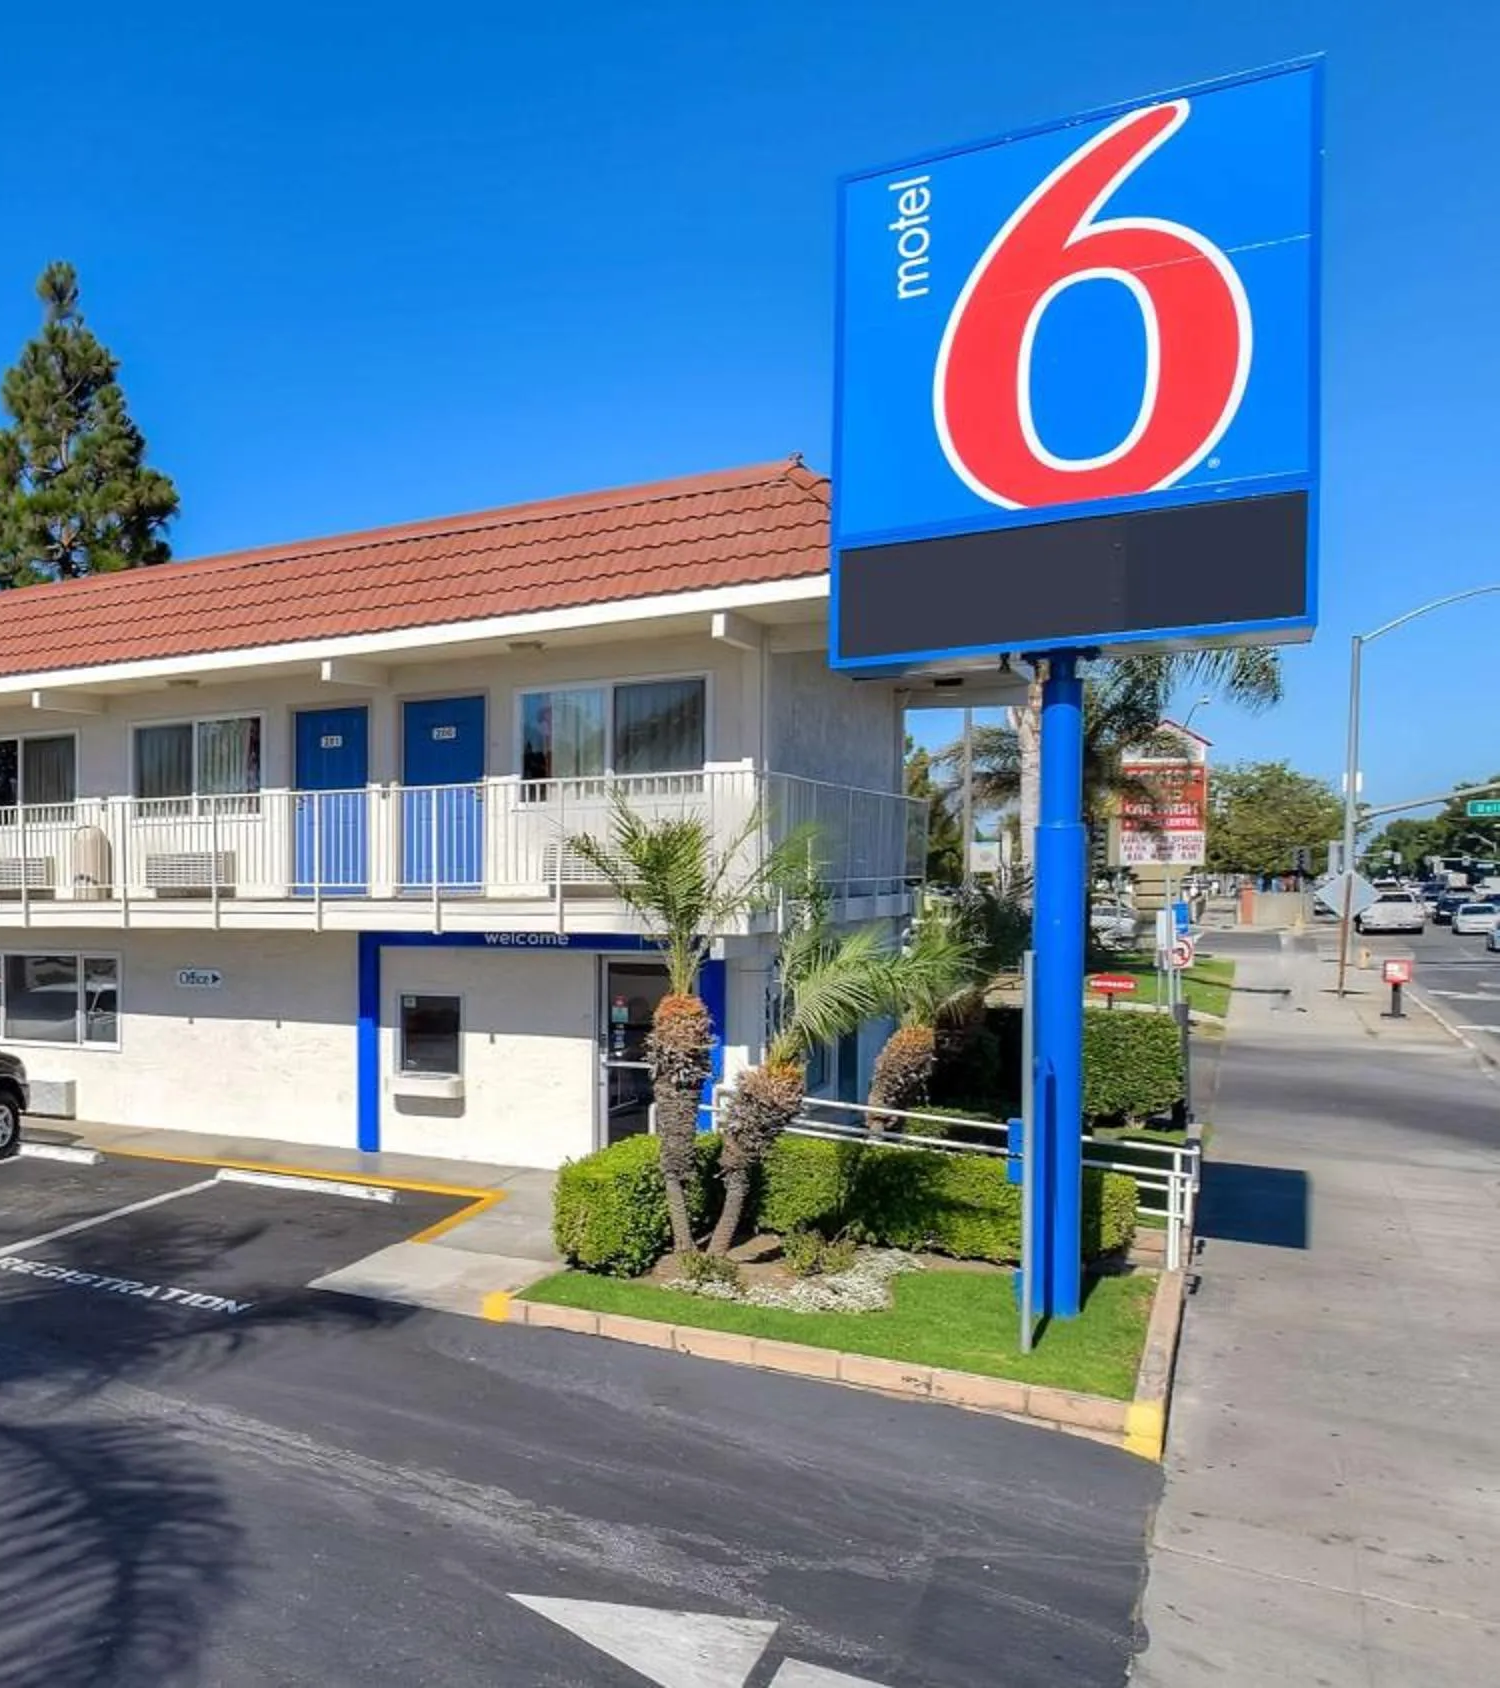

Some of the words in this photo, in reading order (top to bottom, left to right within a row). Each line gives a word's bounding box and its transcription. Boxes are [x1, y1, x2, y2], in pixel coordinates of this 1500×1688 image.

[888, 175, 931, 299] motel
[933, 97, 1252, 511] 6
[484, 930, 569, 945] welcome
[180, 971, 210, 985] Office
